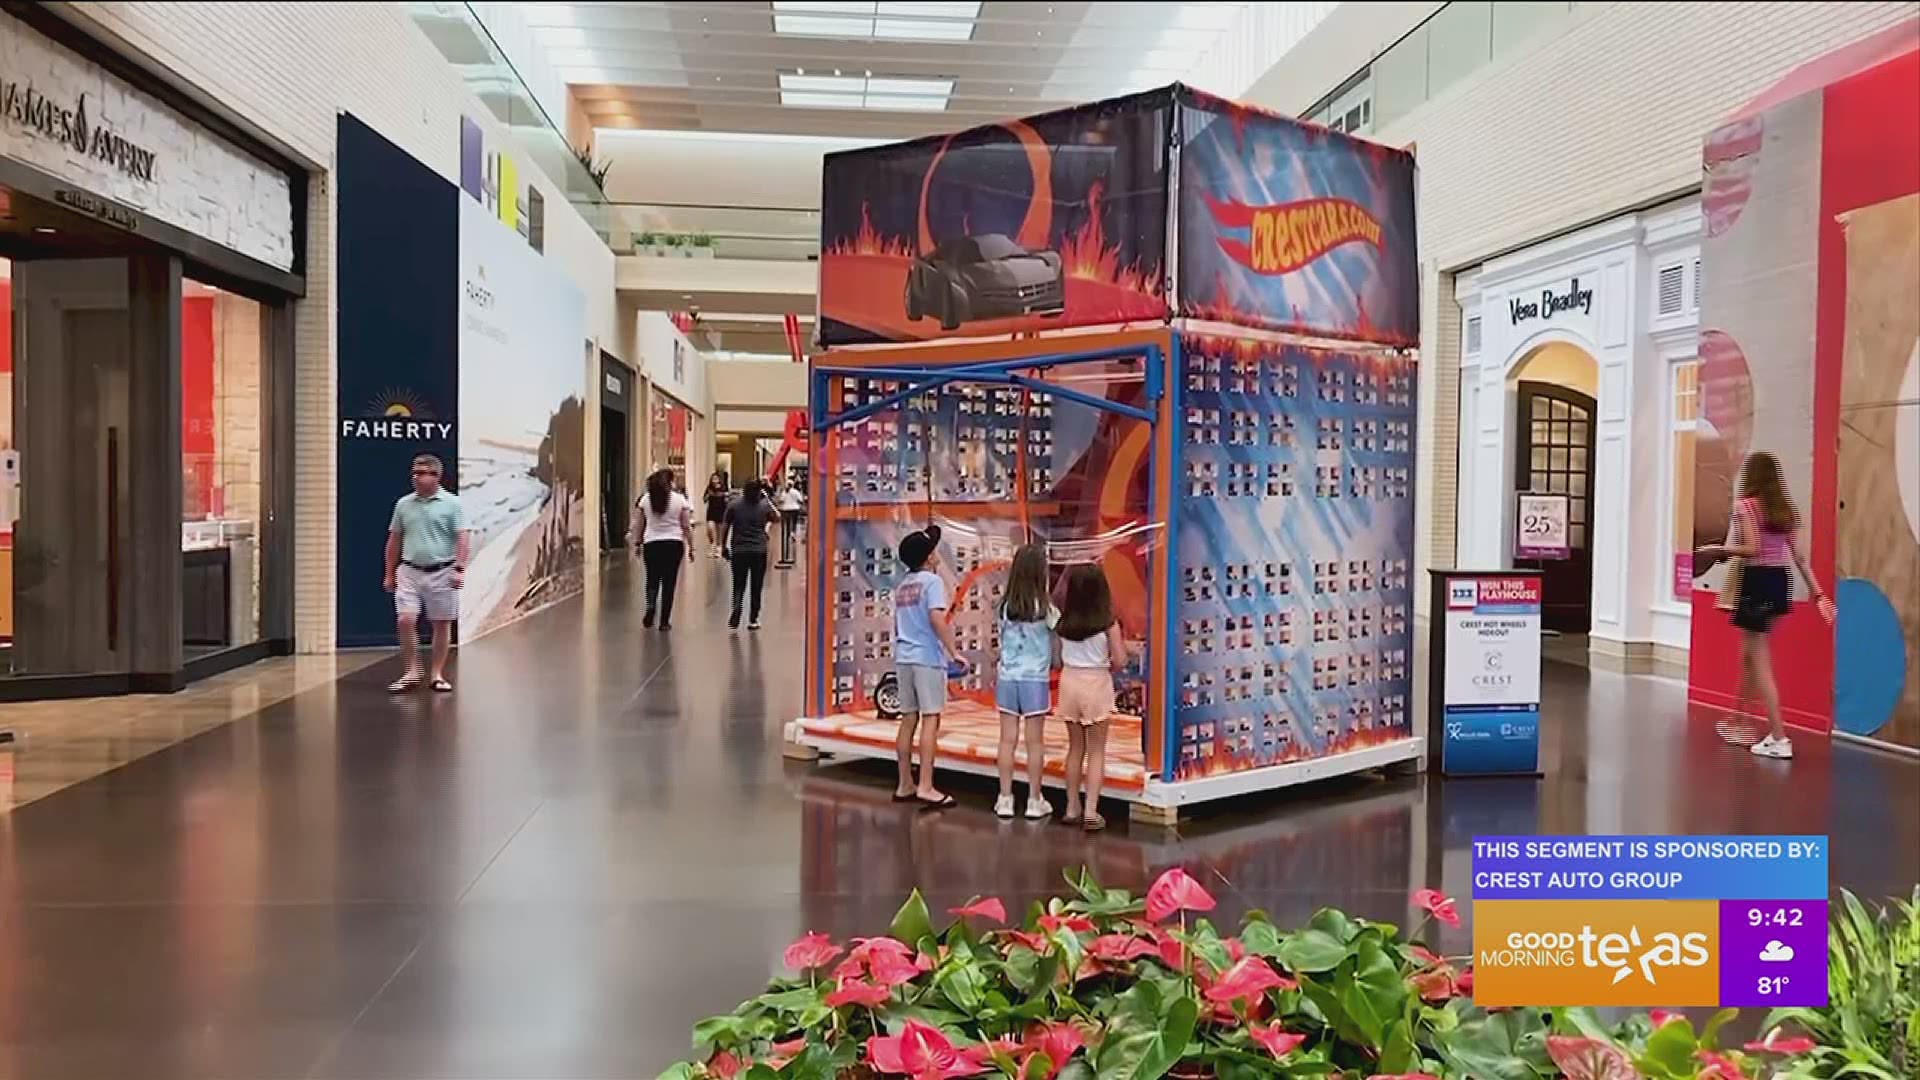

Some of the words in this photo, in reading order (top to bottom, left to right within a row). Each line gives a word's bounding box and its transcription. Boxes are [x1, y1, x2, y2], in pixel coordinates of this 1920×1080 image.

[0, 78, 73, 143] AMES
[89, 125, 158, 184] AVERY
[1509, 297, 1538, 326] Vera
[1541, 278, 1593, 319] Bradley
[342, 420, 452, 440] FAHERTY
[1480, 580, 1501, 590] WIN
[1503, 580, 1525, 590] THIS
[1480, 589, 1537, 600] PLAYHOUSE
[1460, 621, 1482, 629] CREST
[1478, 629, 1509, 637] HIDEOUT
[1472, 675, 1512, 686] CREST
